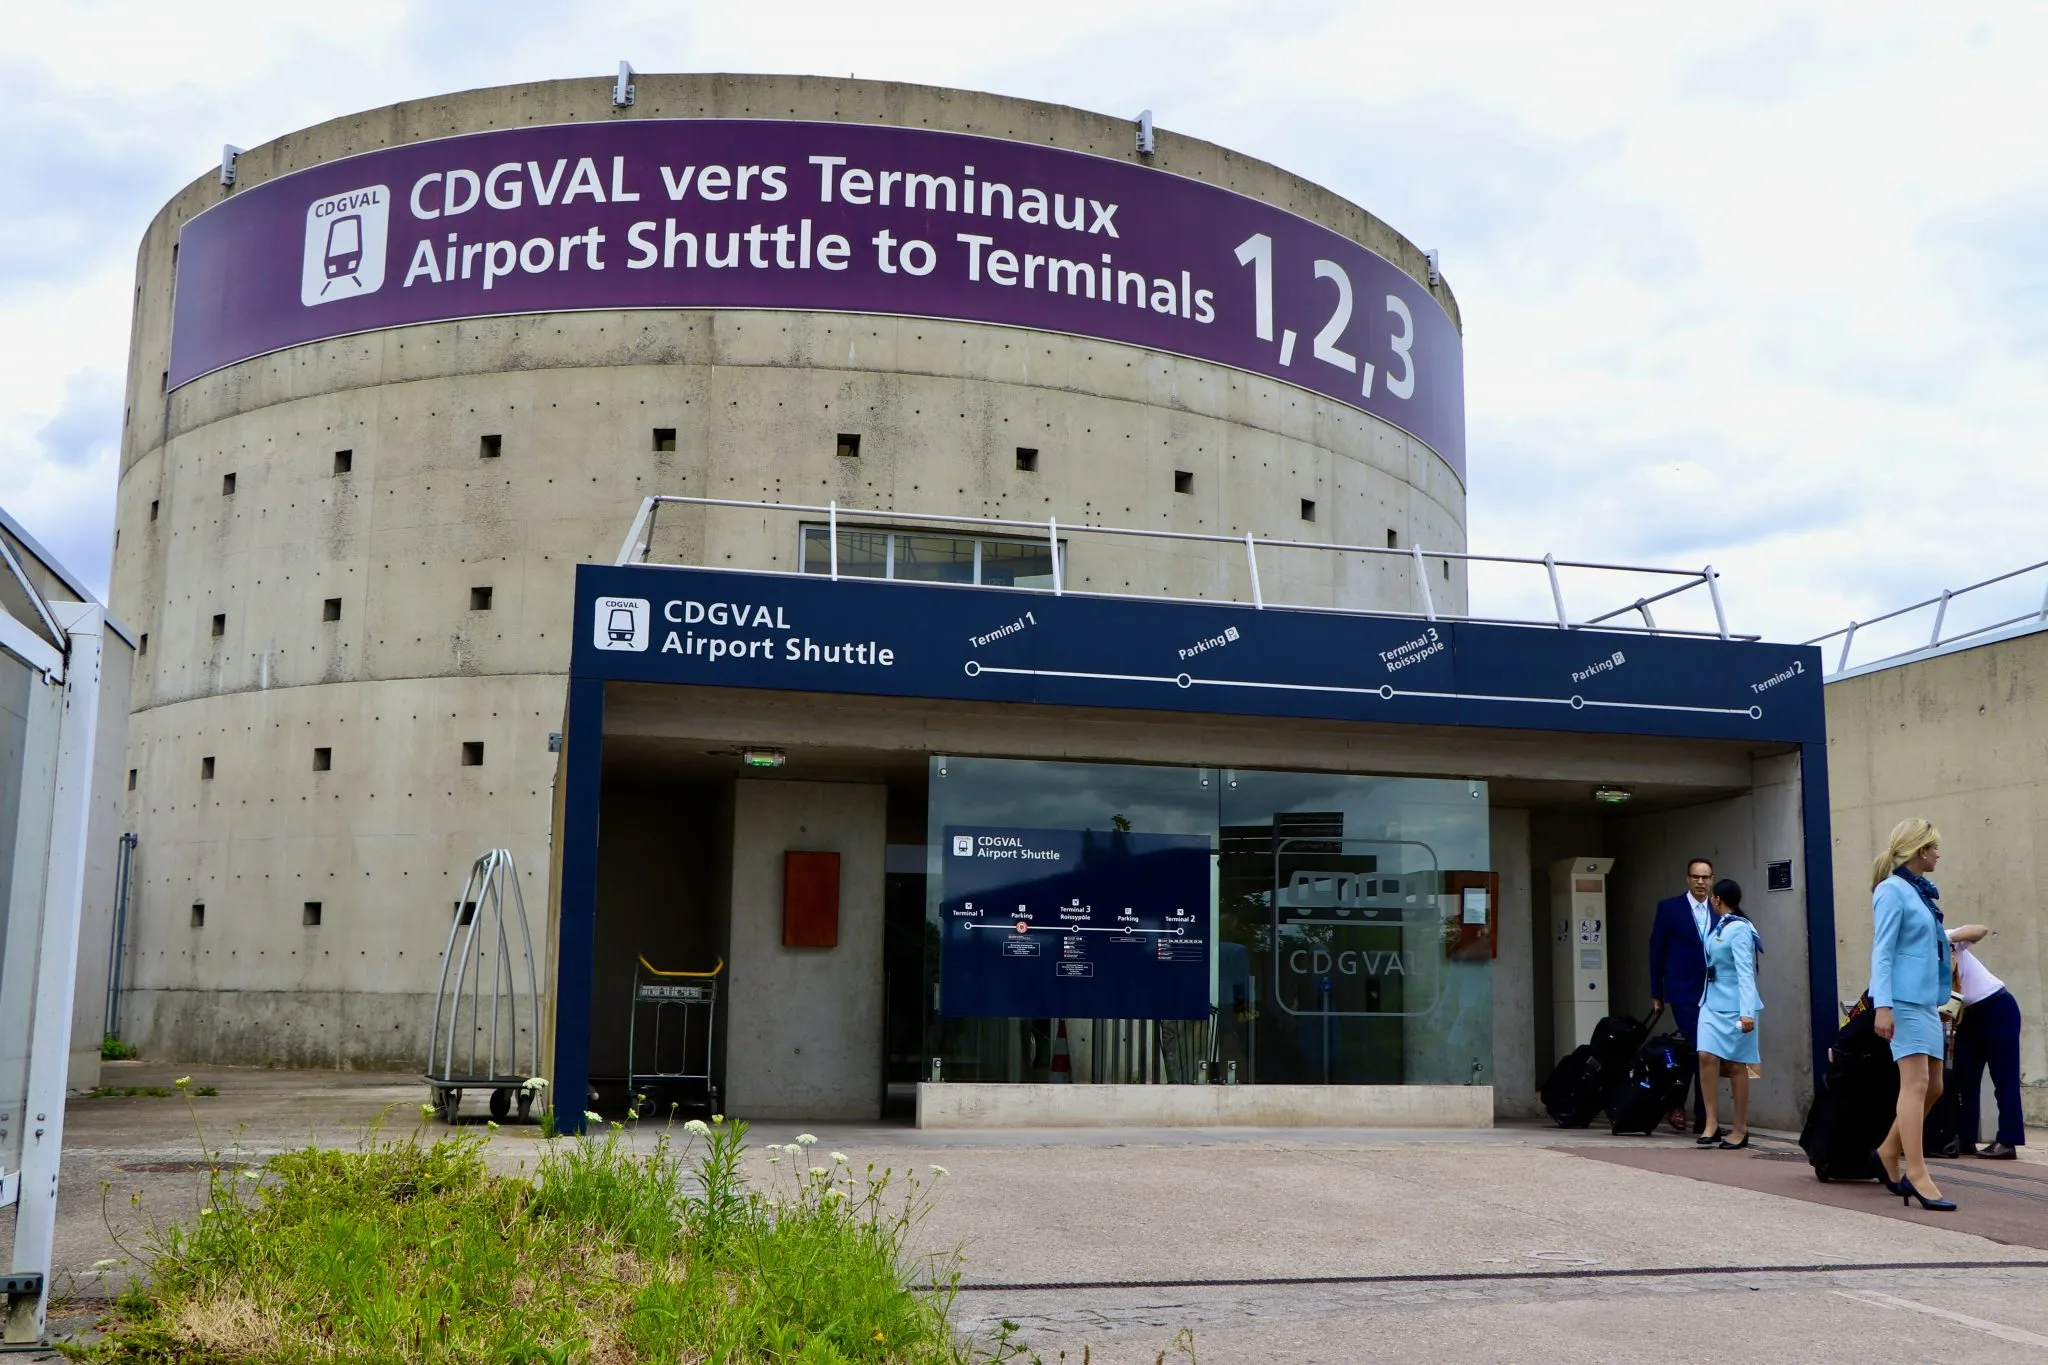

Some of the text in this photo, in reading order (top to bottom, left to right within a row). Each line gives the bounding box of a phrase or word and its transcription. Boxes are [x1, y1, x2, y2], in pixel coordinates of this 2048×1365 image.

[315, 190, 381, 218] CDGVAL
[410, 155, 1120, 239] CDGVAL vers Terminaux
[403, 218, 1216, 325] Airport Shuttle to Terminals
[604, 600, 640, 609] CDGVAL
[663, 600, 791, 629] CDGVAL
[968, 611, 1035, 649] Terminal 1
[661, 630, 895, 666] Airport Shuttle
[1178, 634, 1226, 661] Parking
[1378, 627, 1439, 662] Terminal 3
[1386, 641, 1445, 673] Roissypole
[1571, 659, 1614, 683] Parking
[1750, 660, 1806, 694] Terminal 2
[977, 836, 1023, 848] CDGVAL
[977, 847, 1061, 861] Airport Shuttle
[952, 908, 984, 917] Terminal 1
[1011, 911, 1033, 920] Parking
[1059, 904, 1092, 913] Terminal 3
[1117, 914, 1140, 923] Parking
[1165, 914, 1197, 923] Terminal 2
